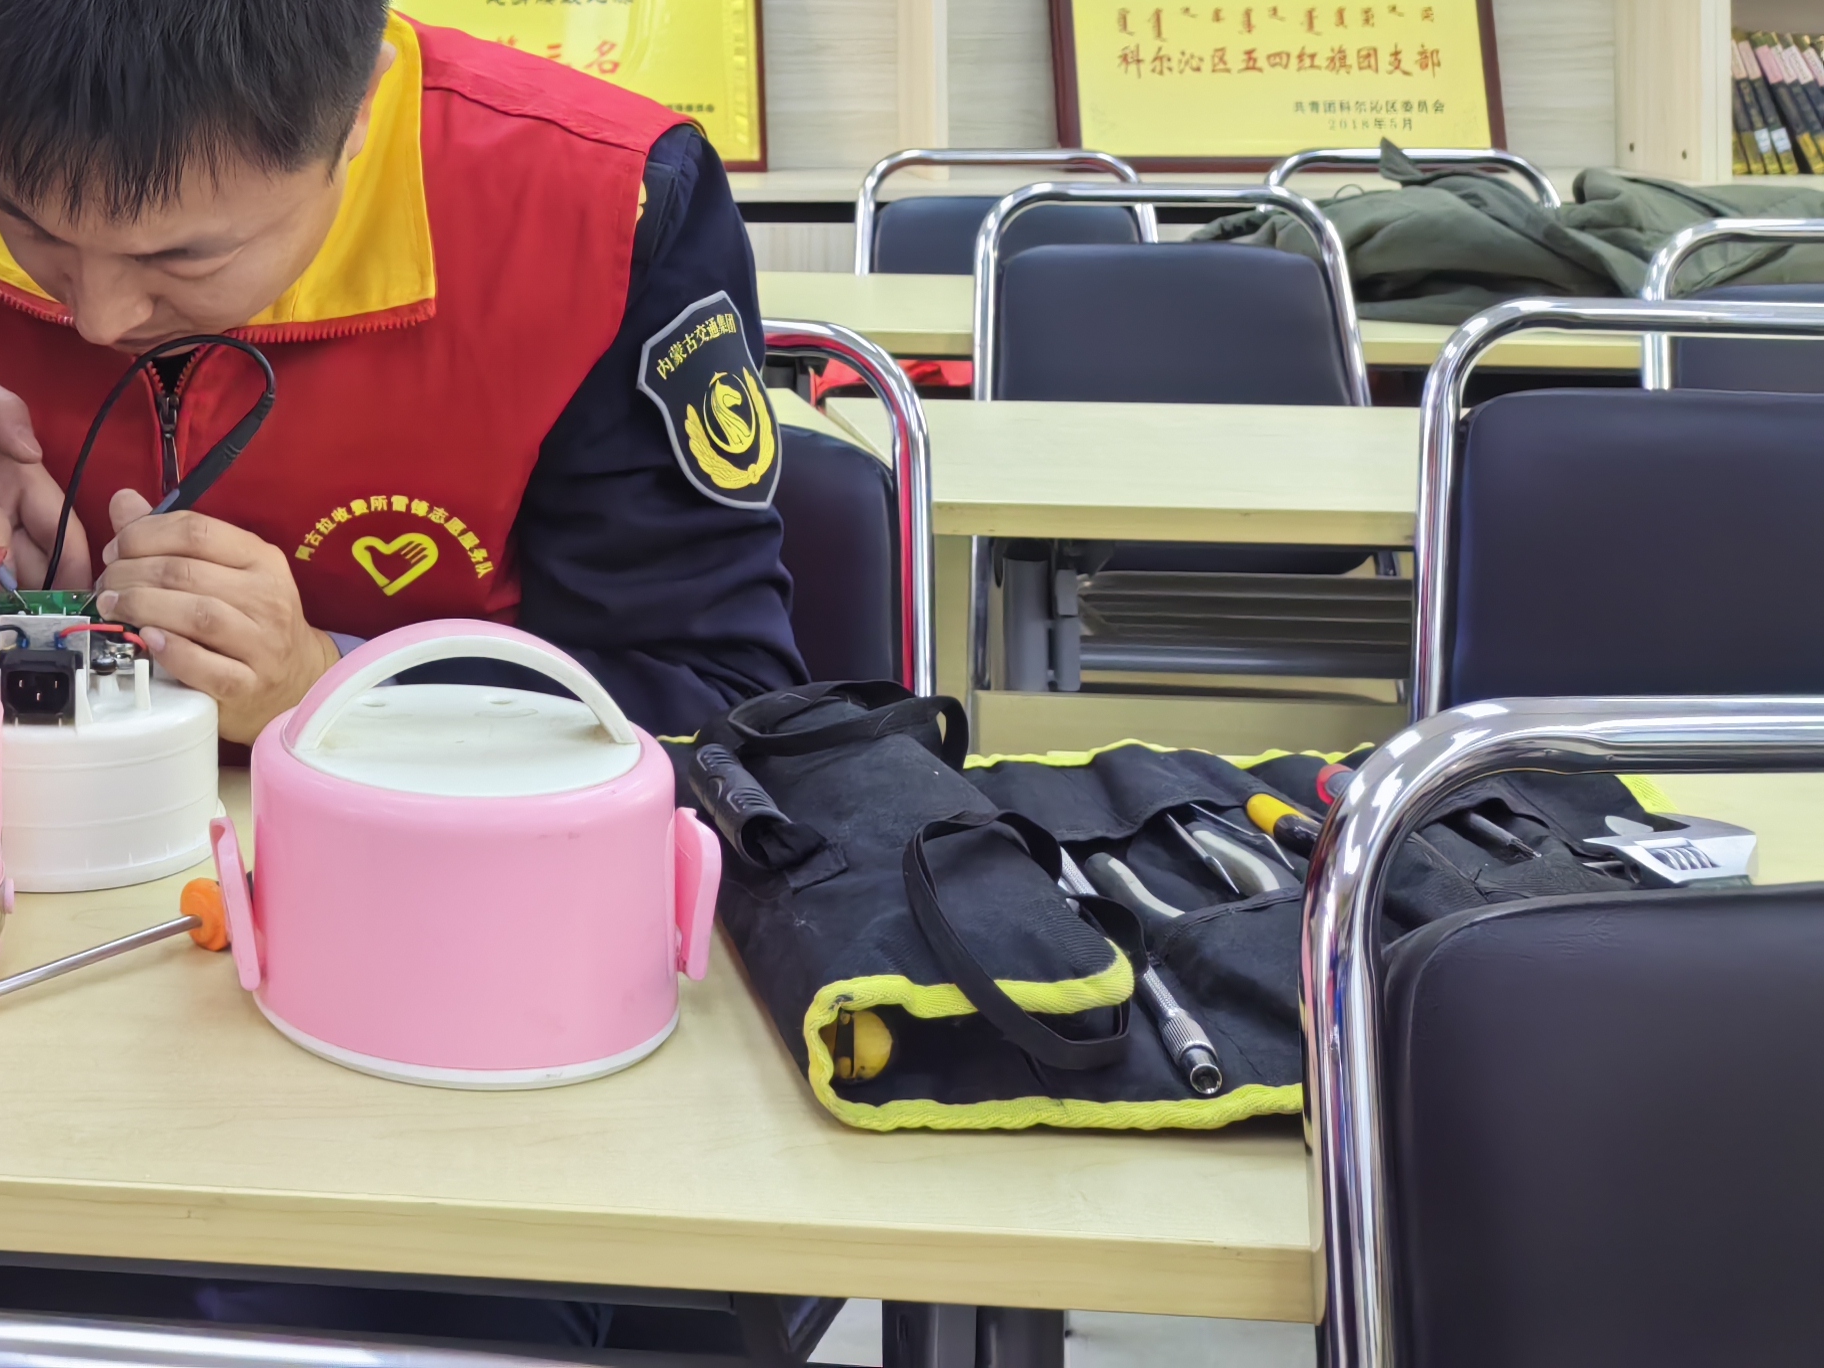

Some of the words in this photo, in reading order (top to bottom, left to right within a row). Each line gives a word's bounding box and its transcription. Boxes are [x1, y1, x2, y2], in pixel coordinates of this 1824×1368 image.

[1117, 43, 1442, 78] 科尔沁区五四红旗团支部
[656, 313, 737, 380] 内蒙古交通集团
